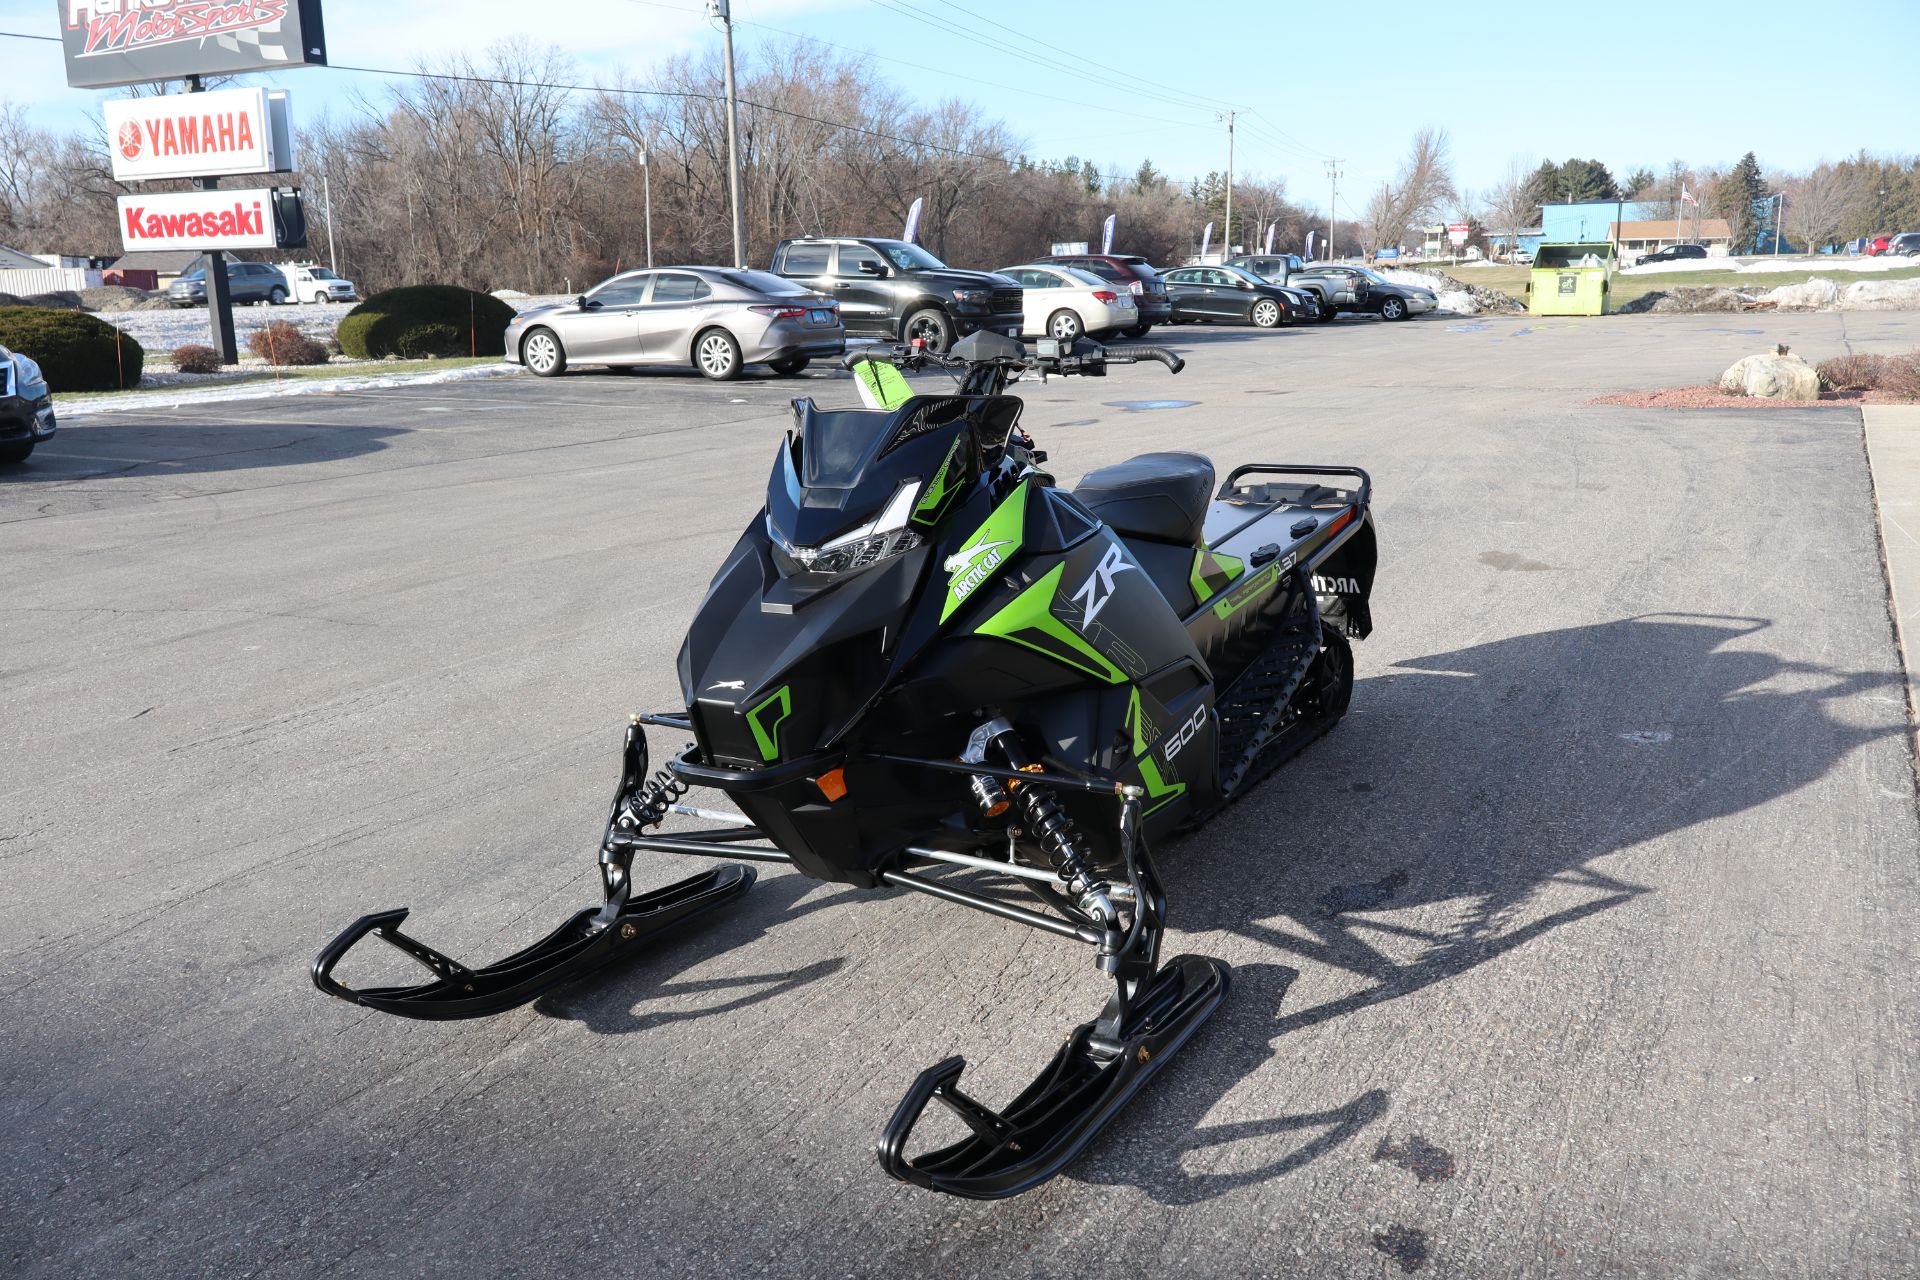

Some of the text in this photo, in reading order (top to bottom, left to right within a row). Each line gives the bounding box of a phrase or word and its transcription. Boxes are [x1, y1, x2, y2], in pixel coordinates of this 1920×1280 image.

[145, 111, 254, 157] YAMAHA
[125, 201, 264, 239] Kawasaki
[952, 548, 1003, 602] ARCTIC CAT
[1071, 542, 1136, 632] ZR
[1275, 551, 1298, 575] 137
[1165, 703, 1207, 761] 600
